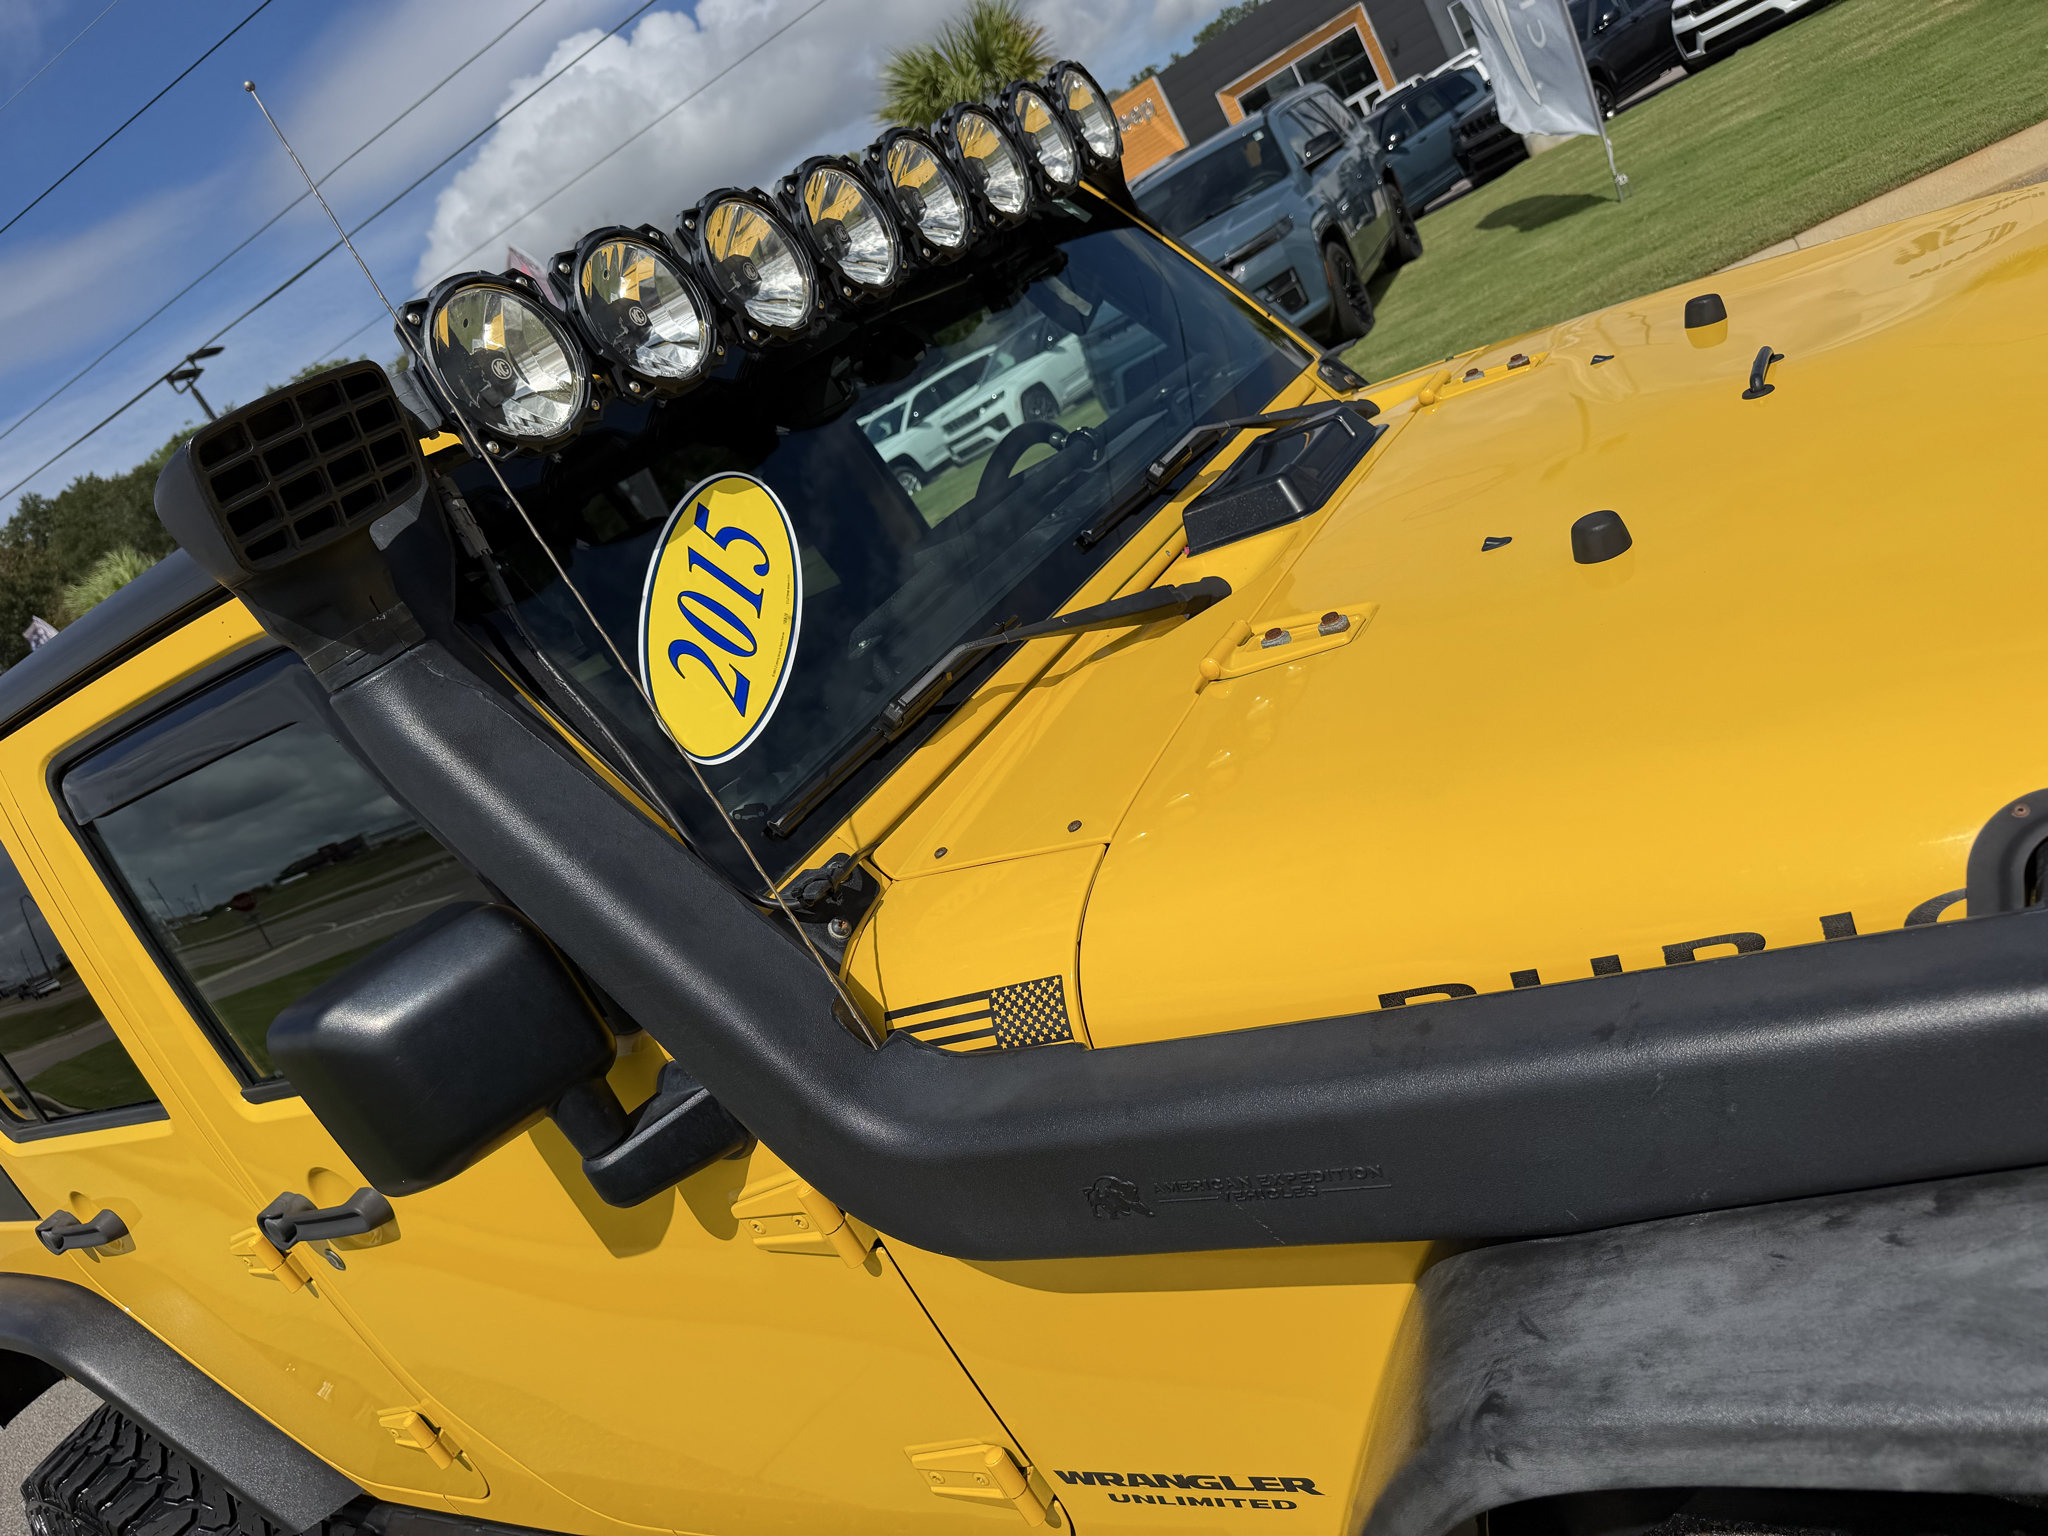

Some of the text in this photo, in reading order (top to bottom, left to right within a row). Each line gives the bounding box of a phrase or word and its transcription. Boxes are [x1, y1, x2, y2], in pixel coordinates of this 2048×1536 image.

[493, 360, 510, 378] KC
[668, 502, 770, 718] 2015
[1153, 1164, 1384, 1194] AMERICAN EXPEDITION
[1219, 1185, 1319, 1202] VEHICLES
[1053, 1469, 1327, 1496] WRANGLER
[1108, 1493, 1298, 1510] UNLIMITED
